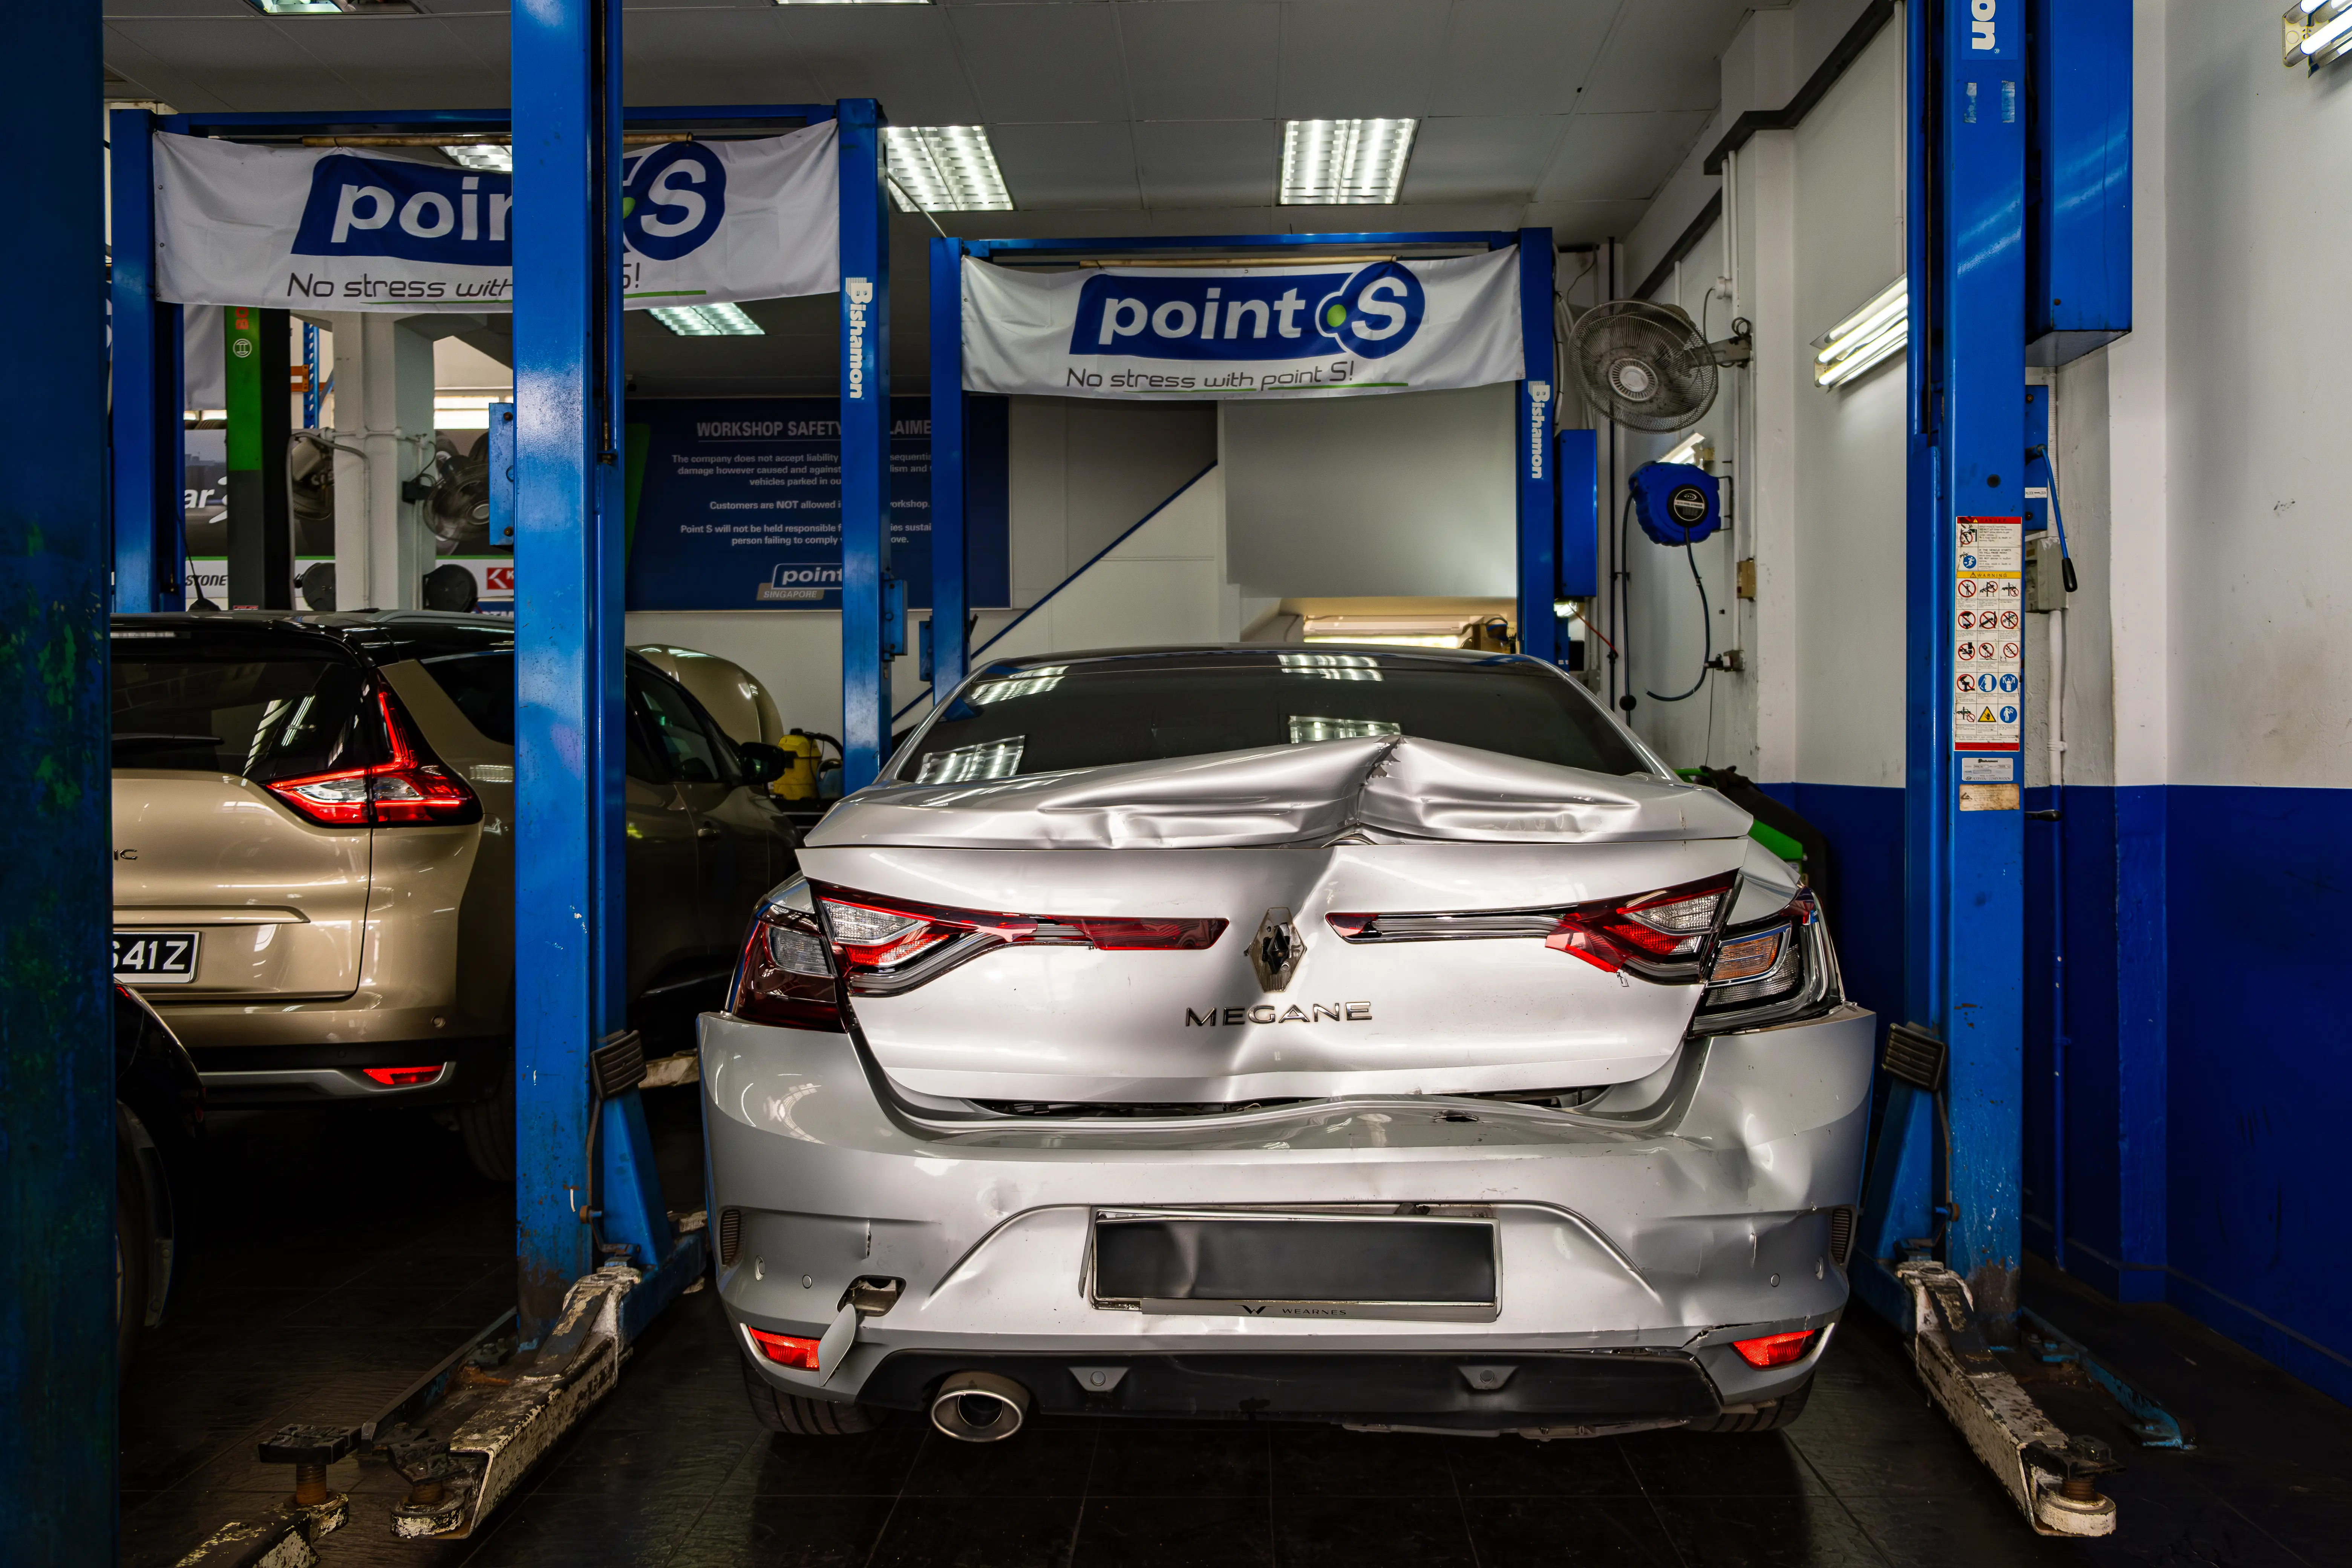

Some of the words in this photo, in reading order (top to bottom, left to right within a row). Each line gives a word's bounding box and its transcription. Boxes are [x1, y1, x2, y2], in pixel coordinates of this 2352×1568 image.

[287, 272, 335, 297] No
[343, 273, 447, 297] stress
[1098, 287, 1306, 345] point
[845, 277, 873, 399] Bishamon
[1066, 368, 1102, 387] No
[1110, 368, 1195, 389] stress
[1204, 371, 1254, 387] with
[1260, 366, 1323, 391] point
[1330, 360, 1355, 382] S!
[697, 421, 783, 437] WORKSHOP
[787, 421, 841, 436] SAFETY
[890, 420, 931, 435] AIME
[1528, 380, 1550, 479] Bishamon
[672, 455, 689, 463] The
[691, 456, 732, 465] company
[775, 455, 804, 463] accept
[807, 453, 839, 463] liability
[678, 467, 714, 475] damage
[809, 466, 841, 475] against
[787, 478, 817, 487] parked
[710, 501, 758, 510] Customers
[801, 501, 835, 509] allowed
[890, 499, 930, 509] orkshop.
[680, 525, 704, 533] Point
[715, 525, 731, 533] will
[764, 524, 783, 533] held
[785, 524, 836, 534] responsible
[731, 538, 762, 546] person
[764, 537, 792, 546] failing
[805, 536, 838, 546] comply
[1185, 1001, 1372, 1027] MEGANE
